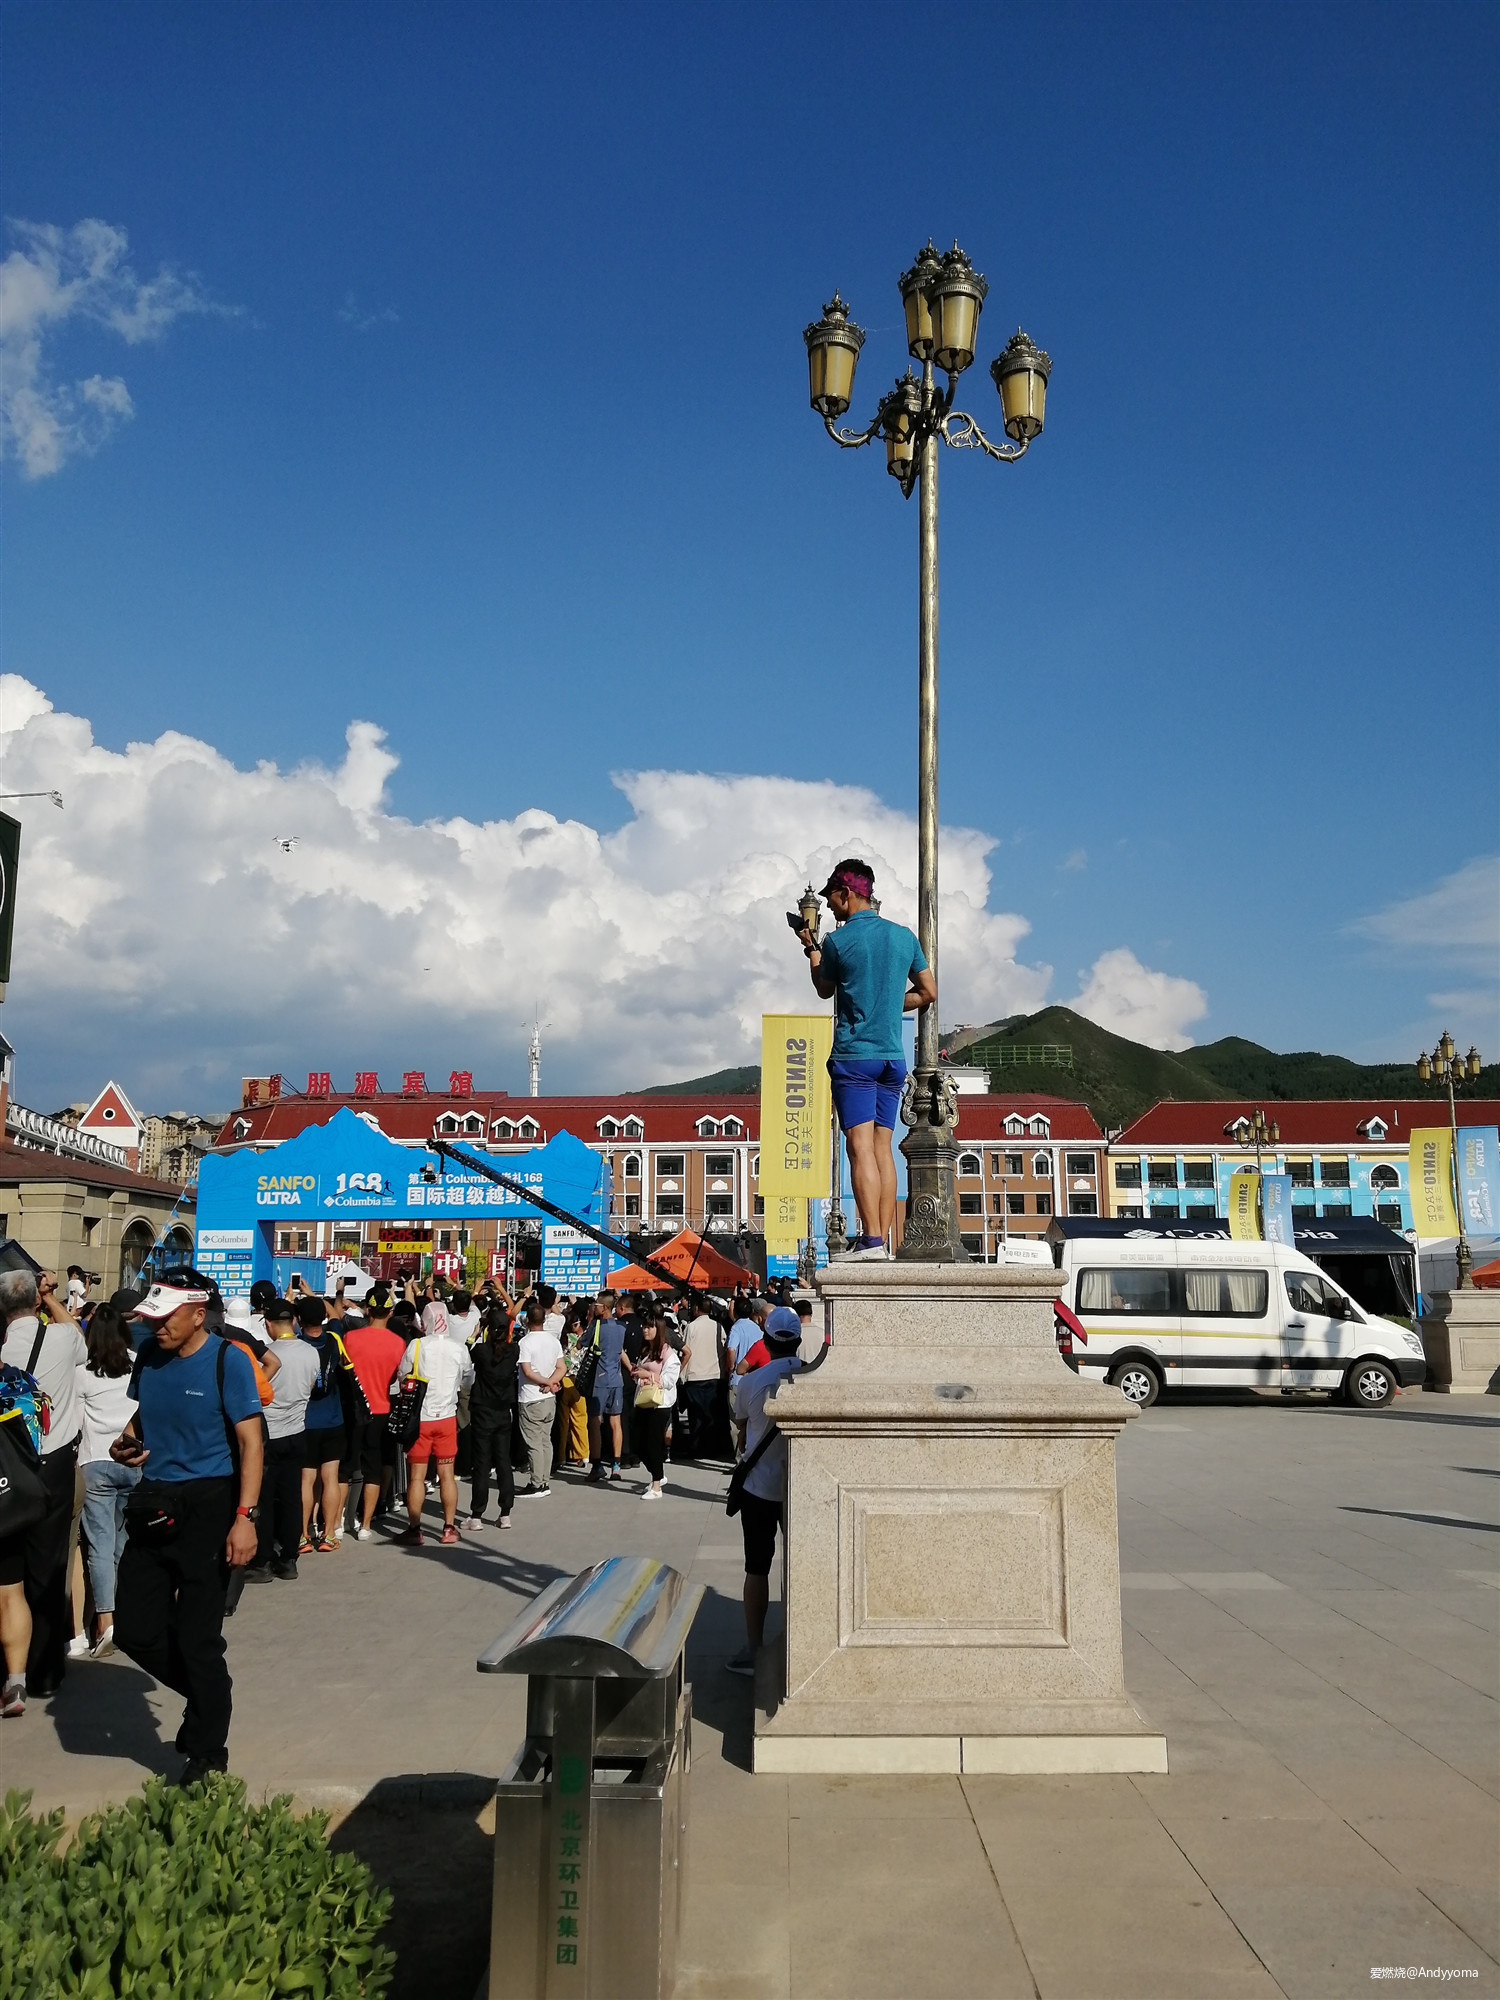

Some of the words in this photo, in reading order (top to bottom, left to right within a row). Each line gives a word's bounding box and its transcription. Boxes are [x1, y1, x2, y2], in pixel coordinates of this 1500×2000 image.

[306, 1070, 473, 1096] 朋源宾馆
[257, 1176, 316, 1190] SANFO
[336, 1172, 382, 1194] 168
[256, 1191, 302, 1205] ULTRA
[334, 1196, 381, 1207] Columbia
[210, 1235, 248, 1244] Columbia
[437, 1253, 460, 1275] 中
[556, 1808, 582, 1966] 北京环卫集团
